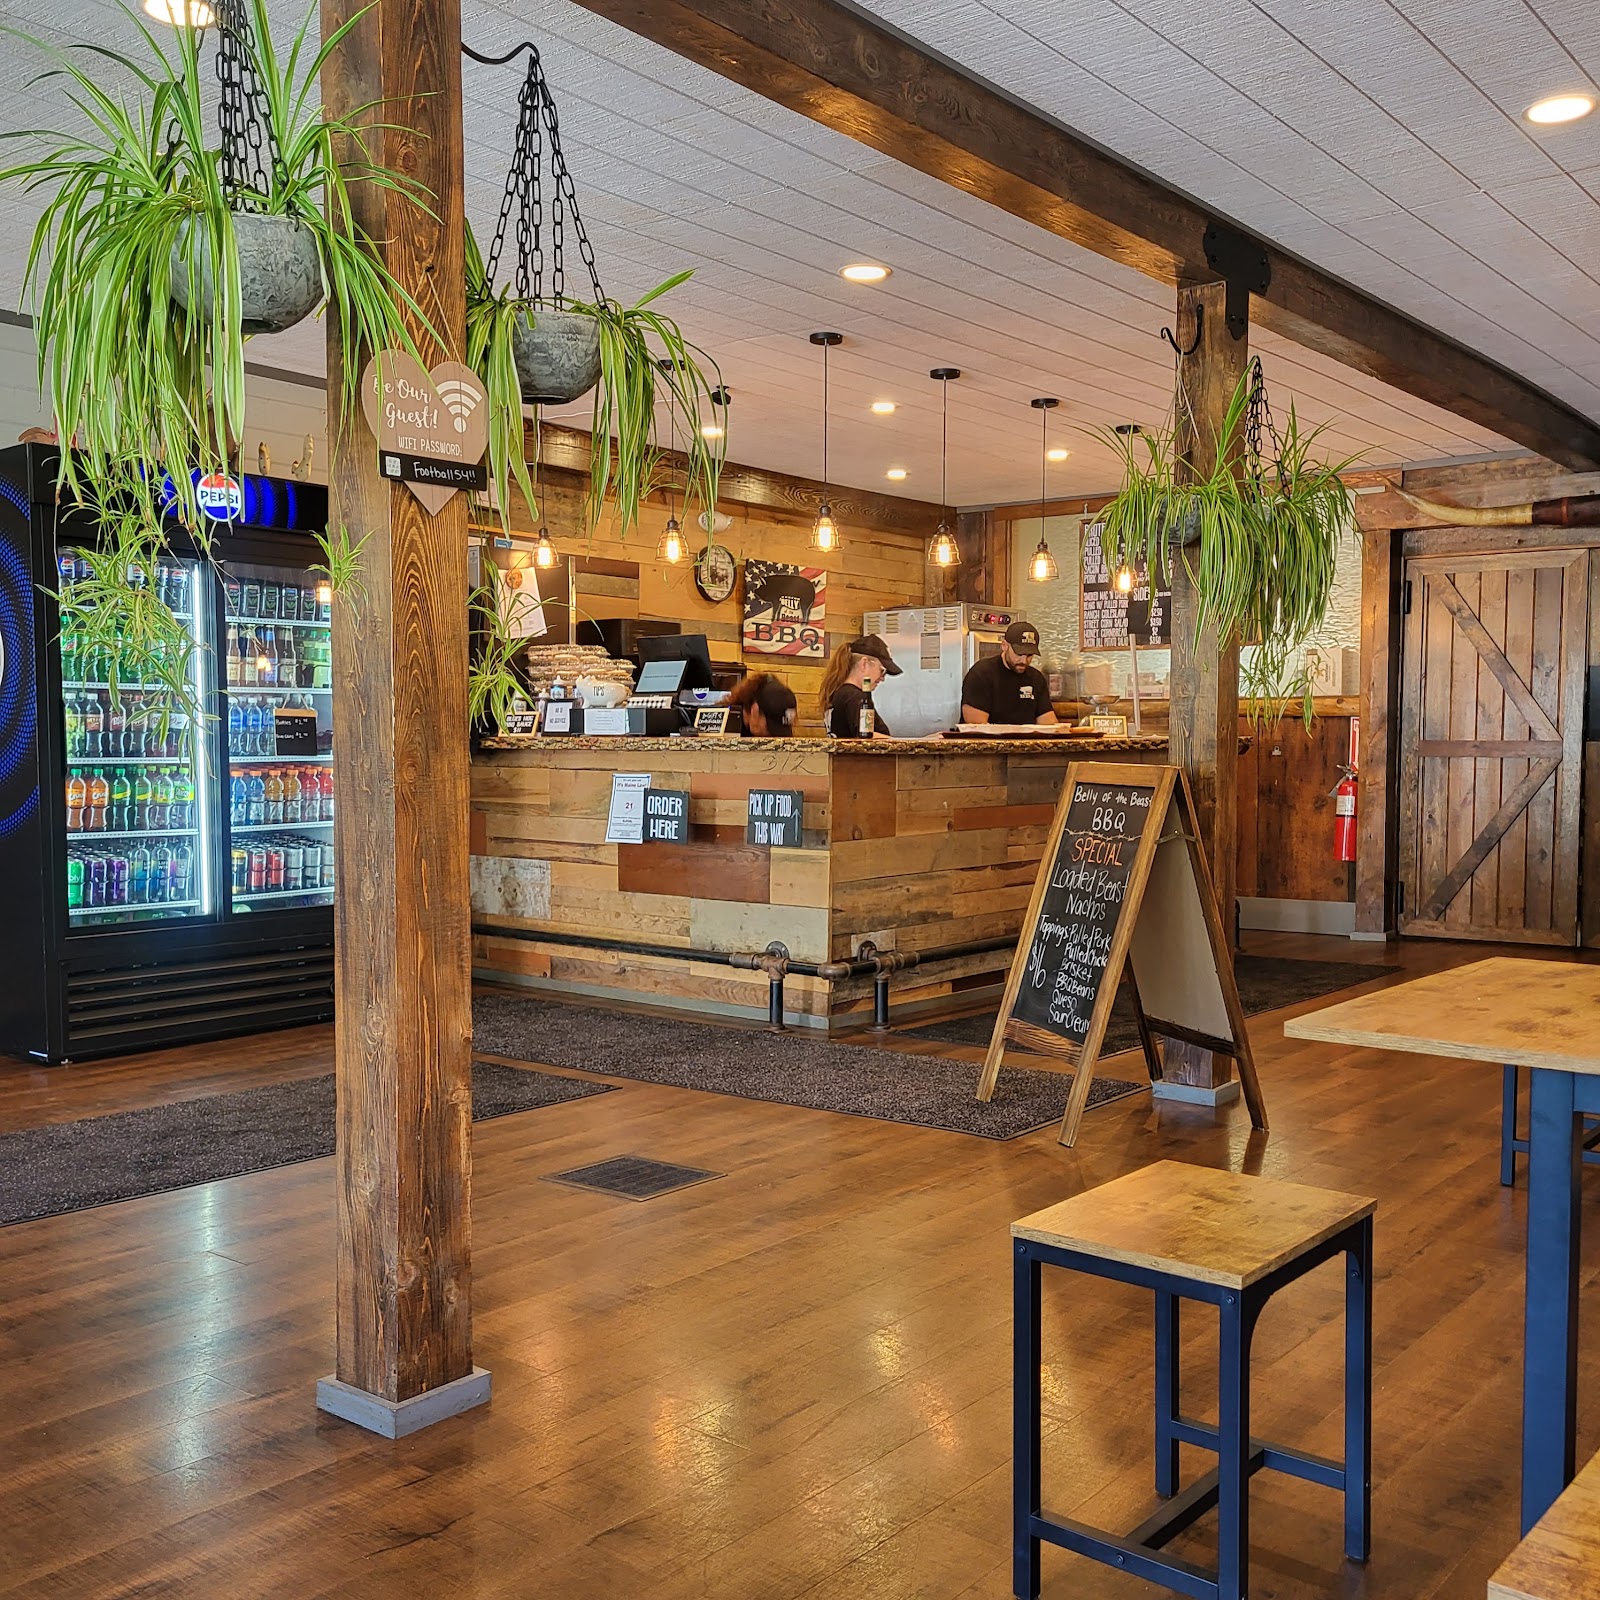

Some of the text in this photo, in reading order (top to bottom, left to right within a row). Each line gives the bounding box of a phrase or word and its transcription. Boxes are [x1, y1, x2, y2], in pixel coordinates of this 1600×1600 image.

[396, 378, 432, 403] Our
[384, 402, 439, 429] Guest!
[398, 436, 463, 457] WIFI PASSWORD:
[200, 490, 239, 504] PEPSI
[1084, 608, 1127, 620] RANCH COLESLAW
[1084, 618, 1129, 629] STREET CORN SALAD
[751, 622, 820, 652] BBQ
[1101, 628, 1128, 638] CORNBREAD
[593, 685, 605, 697] TIPS
[1094, 719, 1123, 727] PICK UP
[625, 802, 634, 810] 21
[646, 795, 682, 817] ORDER
[750, 793, 792, 818] PICK UP FOOD
[1074, 785, 1153, 807] Belly of the Beast
[649, 818, 679, 840] HERE
[1092, 807, 1126, 832] BBQ
[754, 821, 786, 846] THIS WAY
[1071, 836, 1122, 866] SPECIAL
[1052, 860, 1131, 903] Loaded Beast
[1065, 893, 1106, 921] Nachos
[1069, 923, 1095, 948] Pulled
[1093, 927, 1111, 951] Pork
[1064, 942, 1090, 965] Pulled
[1060, 957, 1092, 983] Brisket
[1055, 971, 1096, 1000] BBQ Beans
[1052, 989, 1077, 1010] Queso
[1048, 1003, 1069, 1024] Sour
